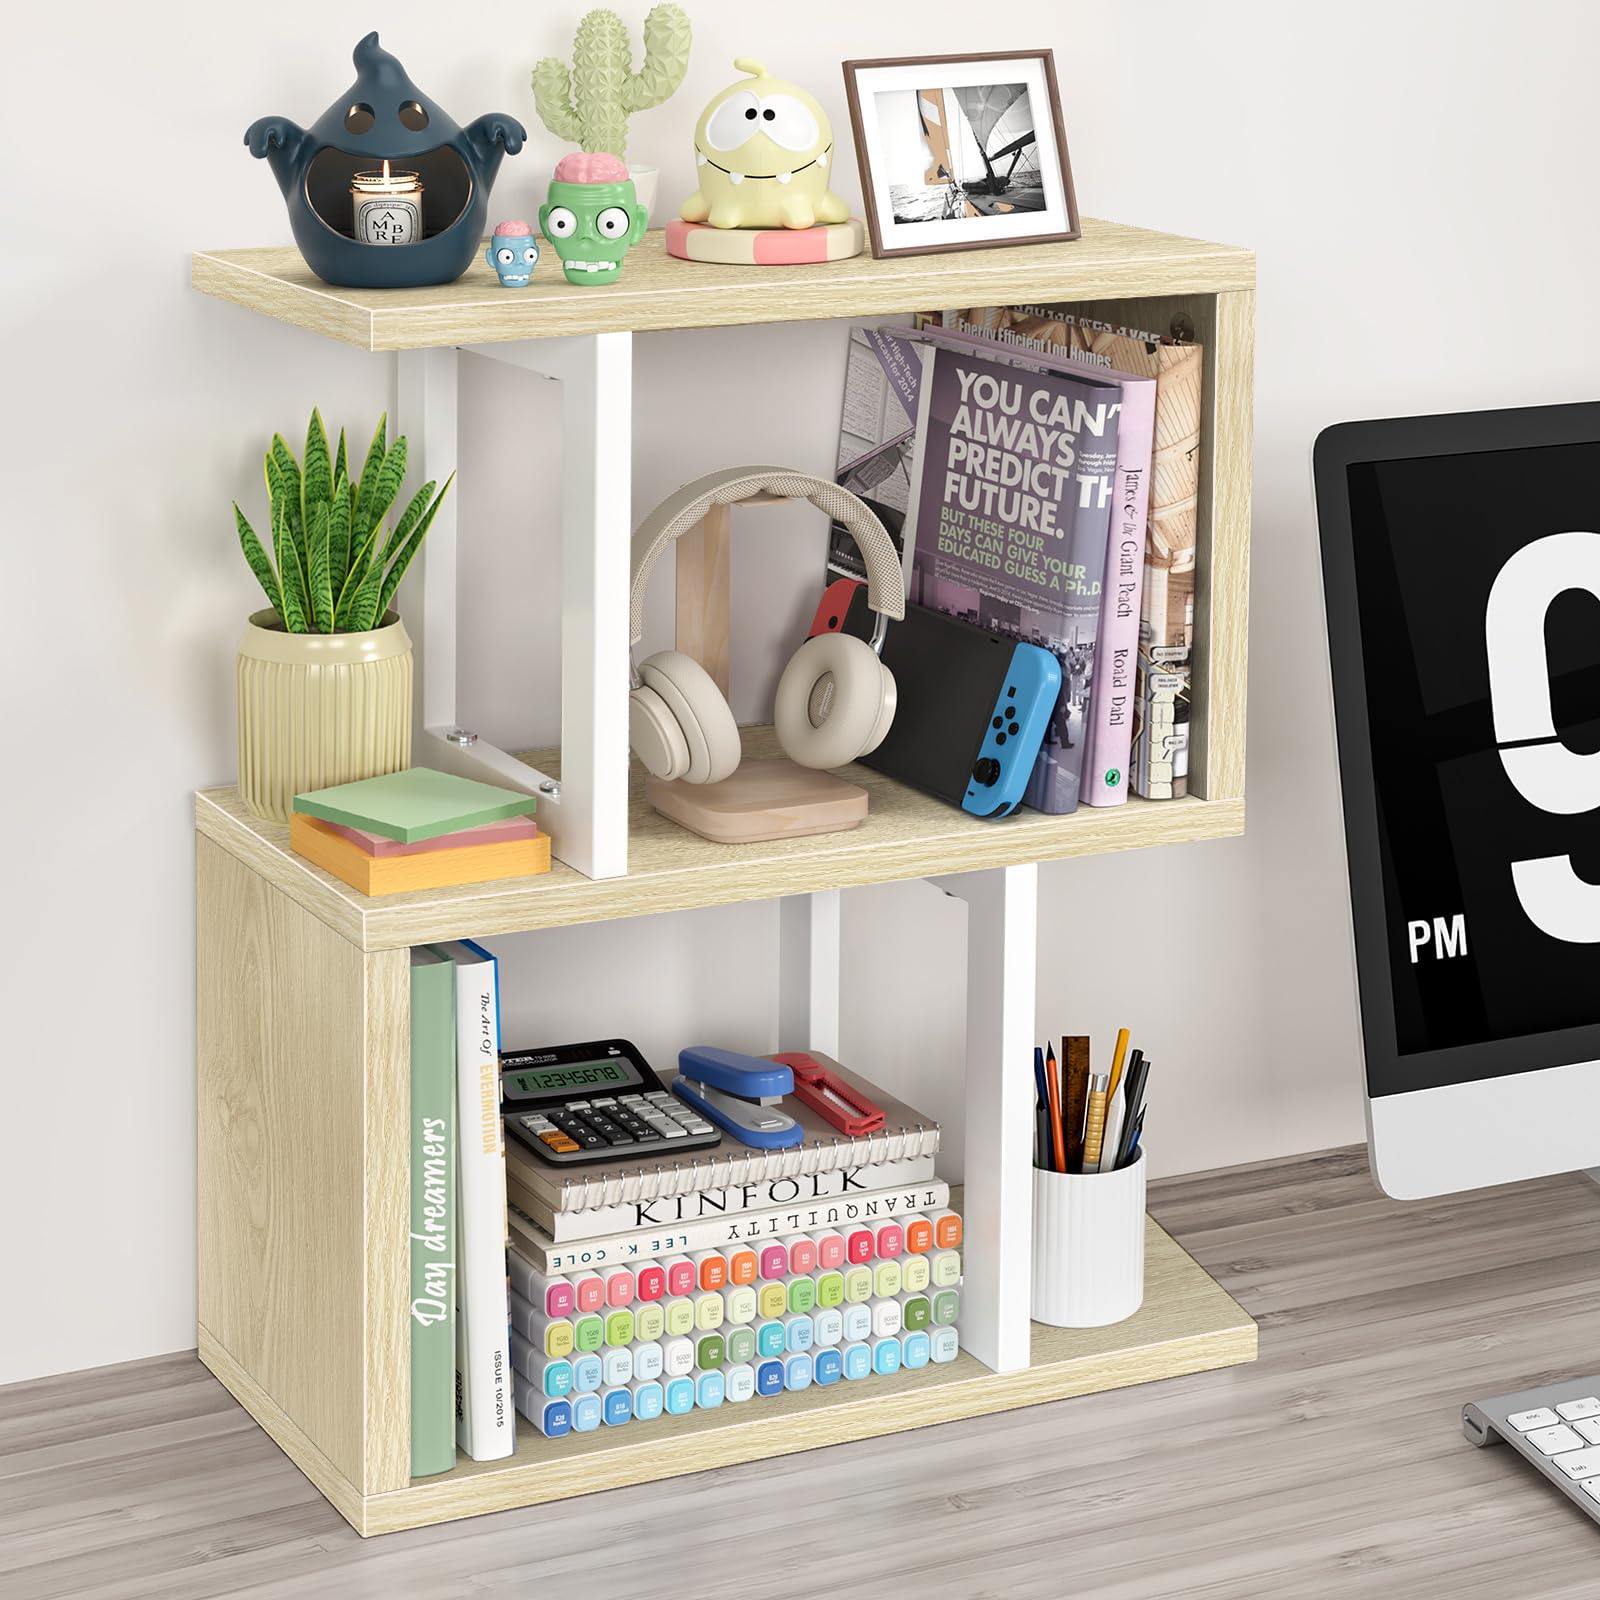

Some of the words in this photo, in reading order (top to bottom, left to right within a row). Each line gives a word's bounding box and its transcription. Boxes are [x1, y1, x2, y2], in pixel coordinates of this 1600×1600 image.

[959, 318, 997, 341] Energy
[998, 327, 1045, 353] Efficient
[1069, 346, 1113, 370] Homes
[872, 330, 893, 364] orecast
[890, 361, 901, 377] for
[898, 377, 915, 402] 2014
[956, 368, 1023, 416] YOU
[1029, 389, 1121, 437] CAN'
[949, 404, 1076, 467] ALWAYS
[947, 437, 1070, 501] PREDICT
[1076, 474, 1113, 508] TH
[1119, 464, 1143, 502] James
[943, 471, 1065, 540] FUTURE.
[940, 506, 966, 525] BUT
[968, 515, 1005, 539] THESE
[1008, 528, 1045, 552] FOUR
[1122, 522, 1137, 537] the
[938, 537, 1001, 570] EDUCATED
[1004, 560, 1047, 586] GUESS
[1049, 576, 1060, 591] A
[939, 522, 972, 544] DAYS
[975, 535, 1004, 554] CAN
[1006, 544, 1039, 566] GIVE
[1042, 555, 1087, 580] YOUR
[1119, 540, 1139, 577] Giant
[1116, 581, 1137, 619] Peach
[1112, 648, 1129, 688] Roald
[1109, 696, 1127, 726] Dahl
[1408, 913, 1467, 963] PM
[480, 992, 489, 1012] The
[481, 1014, 492, 1035] Art
[480, 1039, 492, 1056] Of
[532, 1066, 619, 1089] 1.2345678
[480, 1063, 496, 1154] EVERMOTION
[410, 1117, 447, 1252] dreamers
[636, 1166, 867, 1226] KINFOLK
[727, 1191, 936, 1240] TRANQUILITY
[553, 1250, 606, 1268] COLE
[620, 1244, 638, 1255] K.
[652, 1236, 687, 1251] LEE
[410, 1262, 456, 1327] Day
[494, 1350, 502, 1384] ISSUE
[495, 1387, 504, 1428] 10/2015
